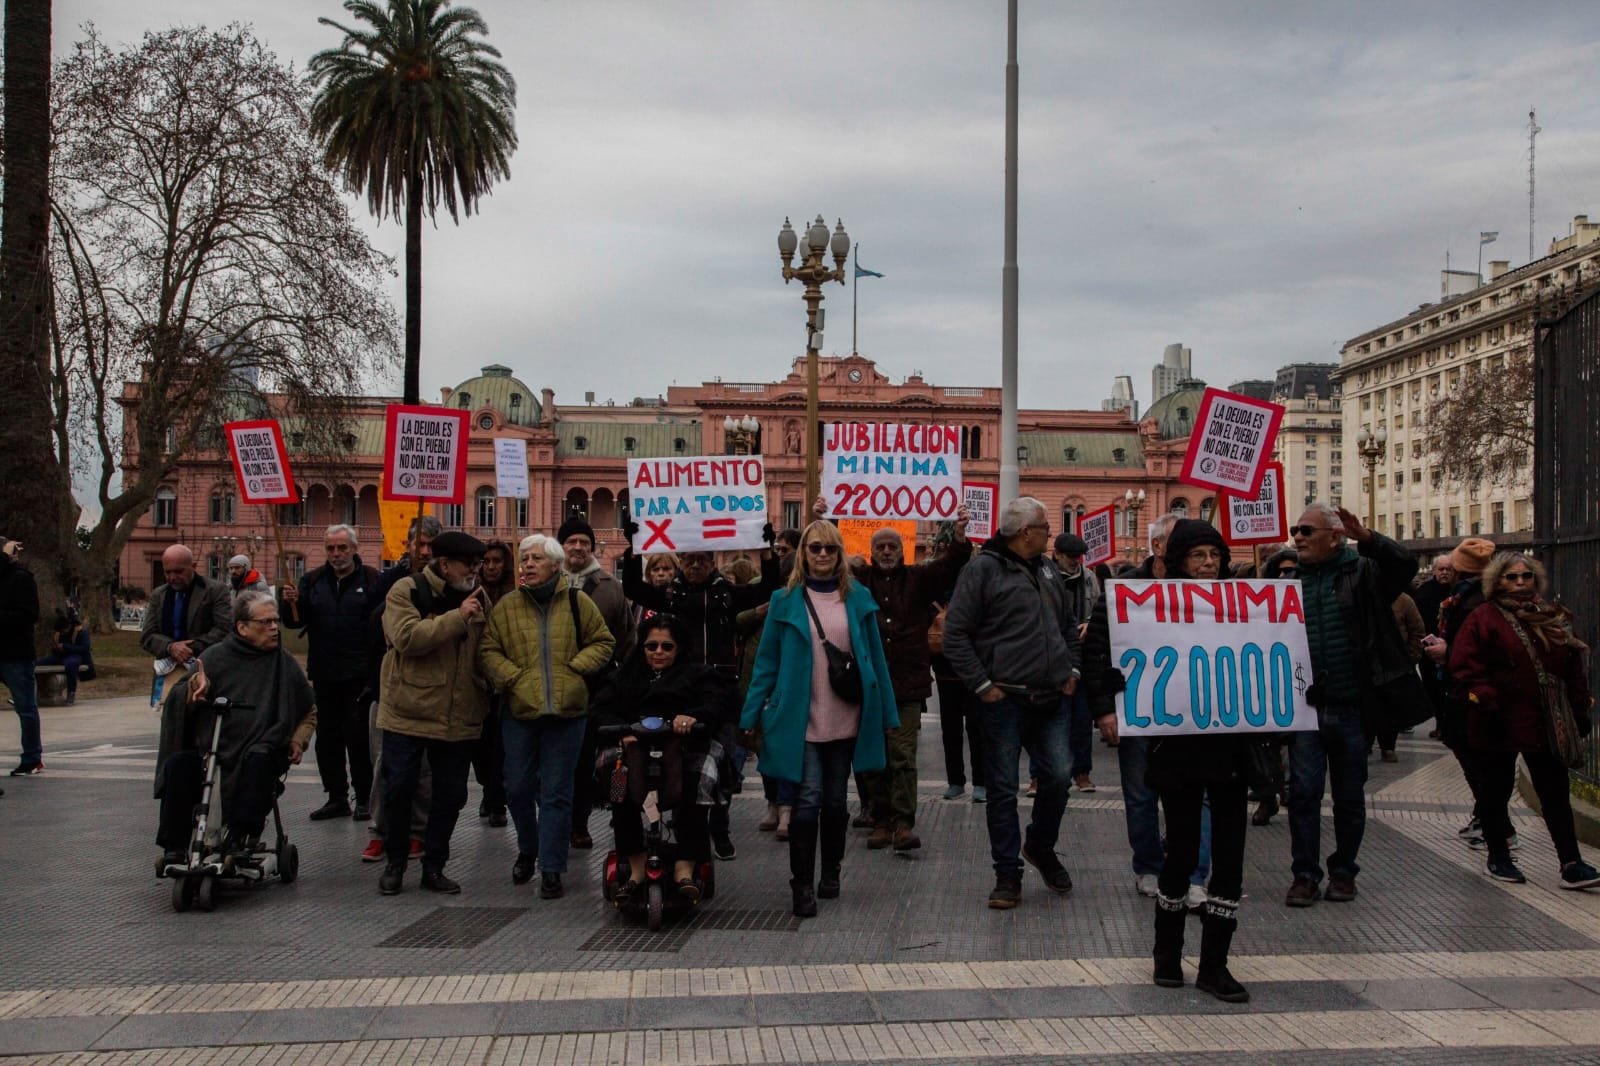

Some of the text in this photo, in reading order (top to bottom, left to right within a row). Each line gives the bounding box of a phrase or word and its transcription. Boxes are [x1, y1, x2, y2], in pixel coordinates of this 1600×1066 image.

[1214, 403, 1264, 429] LA DEUDA ES
[402, 419, 452, 437] LA DEUDA ES
[827, 423, 959, 454] JUBILACION
[1209, 421, 1259, 445] CON EL PUEBLO
[237, 433, 271, 447] LA DEUDA ES
[401, 436, 450, 454] CON EL PUEBLO
[1204, 438, 1255, 463] NO CON EL FMI
[240, 447, 274, 461] CON EL PUEBLO
[400, 454, 450, 471] NO CON EL FMI
[243, 462, 280, 476] NO CON EL FMI
[634, 460, 762, 488] AUMENTO
[837, 455, 948, 476] MINIMA
[1264, 474, 1272, 487] ES
[634, 495, 764, 517] PARA TODOS
[832, 483, 957, 517] 220.000
[1234, 502, 1274, 517] NO CON EL FMI
[1115, 581, 1305, 624] MINIMA
